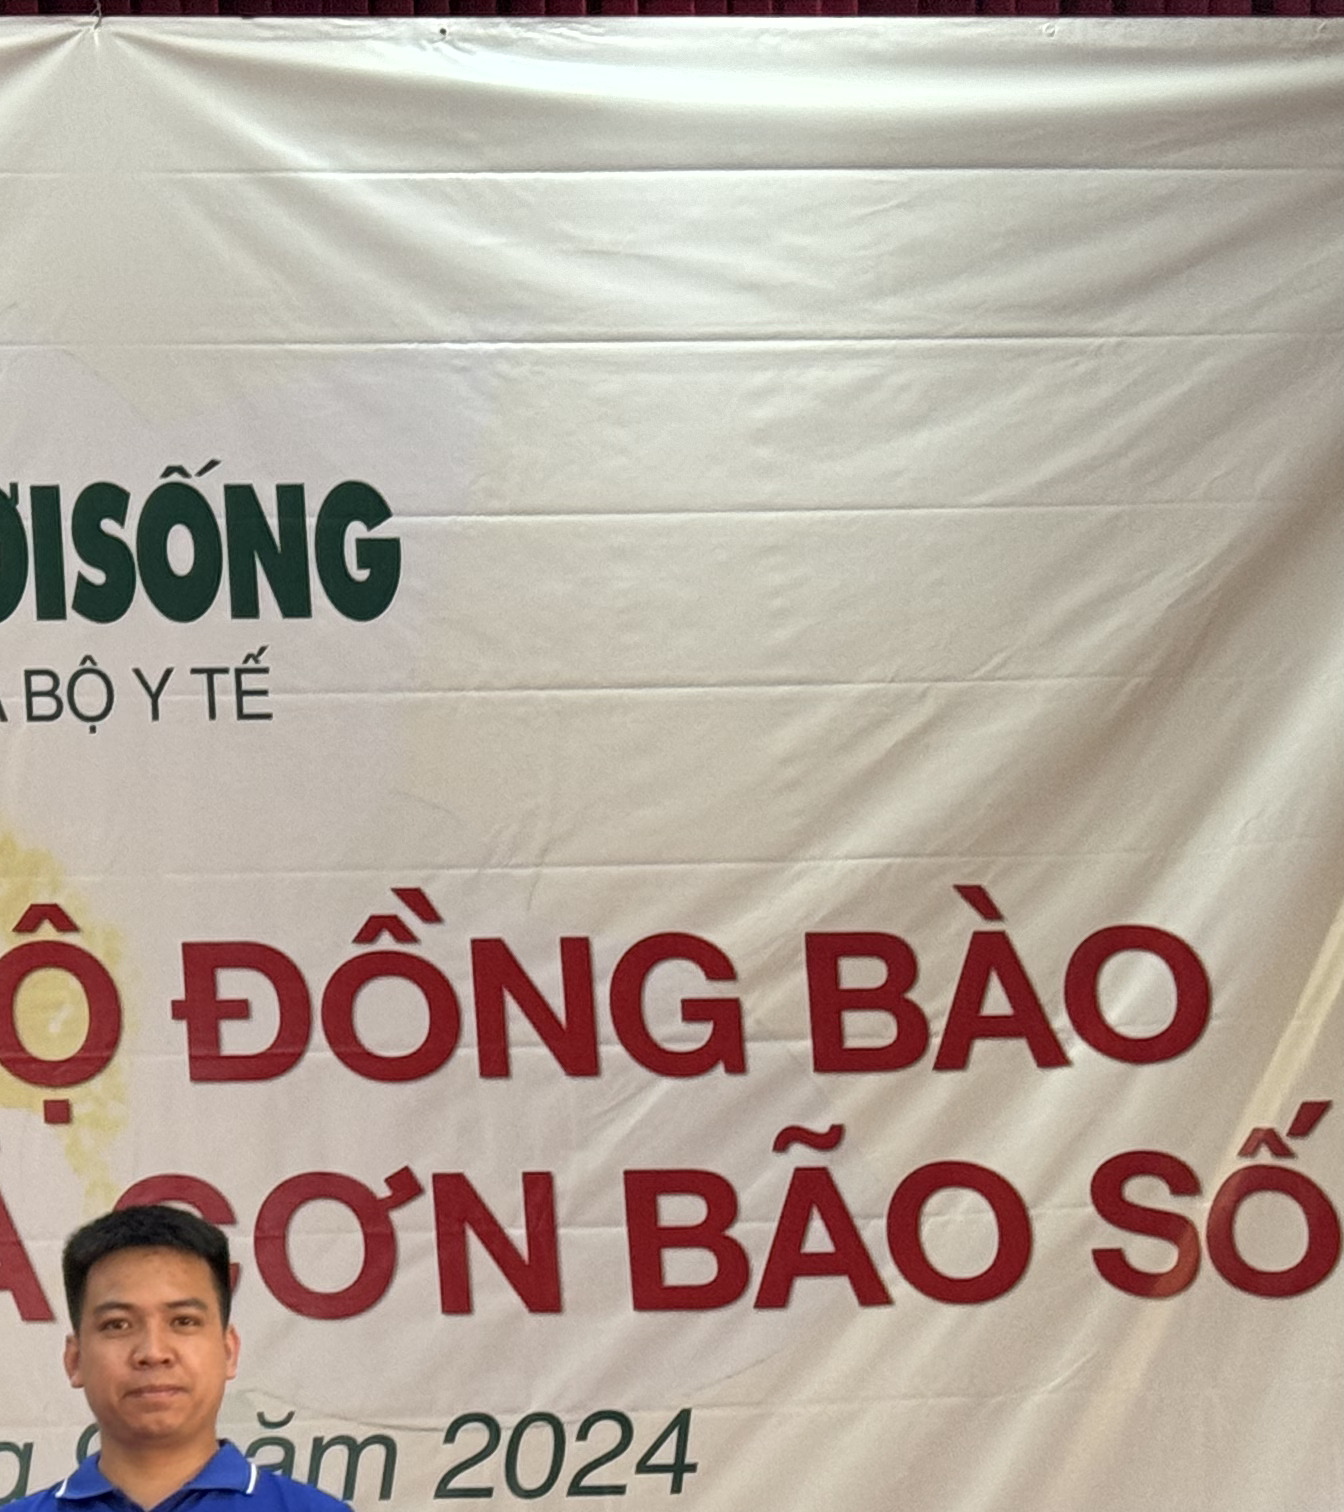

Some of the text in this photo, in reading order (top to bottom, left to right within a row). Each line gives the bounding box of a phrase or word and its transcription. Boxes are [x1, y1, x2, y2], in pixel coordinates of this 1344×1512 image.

[23, 655, 115, 735] BỘ
[133, 667, 175, 722] Y
[190, 645, 274, 721] TẾ
[170, 886, 749, 1084] ĐỒNG
[802, 884, 1213, 1075] BÀO
[623, 1123, 1034, 1313] BÃO
[1088, 1100, 1343, 1299] SỐ
[244, 1410, 398, 1502] ăm
[433, 1407, 699, 1501] 2024
